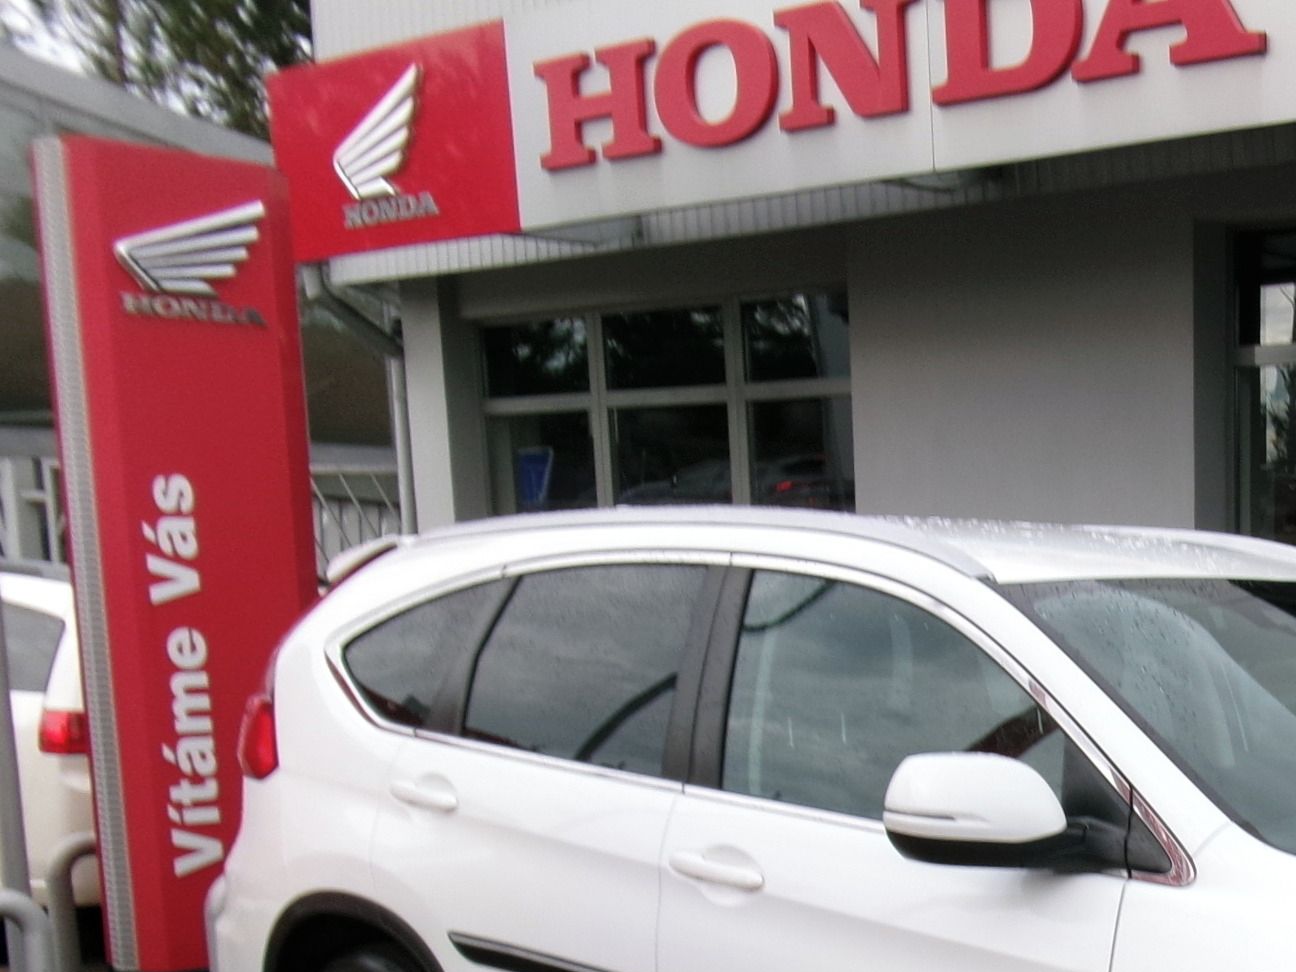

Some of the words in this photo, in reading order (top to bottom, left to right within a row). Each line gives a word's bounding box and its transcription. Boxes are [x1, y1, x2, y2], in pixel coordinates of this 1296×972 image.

[533, 0, 1268, 171] HONDA
[341, 191, 440, 230] HONDA
[119, 291, 268, 327] HONDA
[142, 473, 202, 606] Vás
[161, 626, 224, 878] Vítáme
